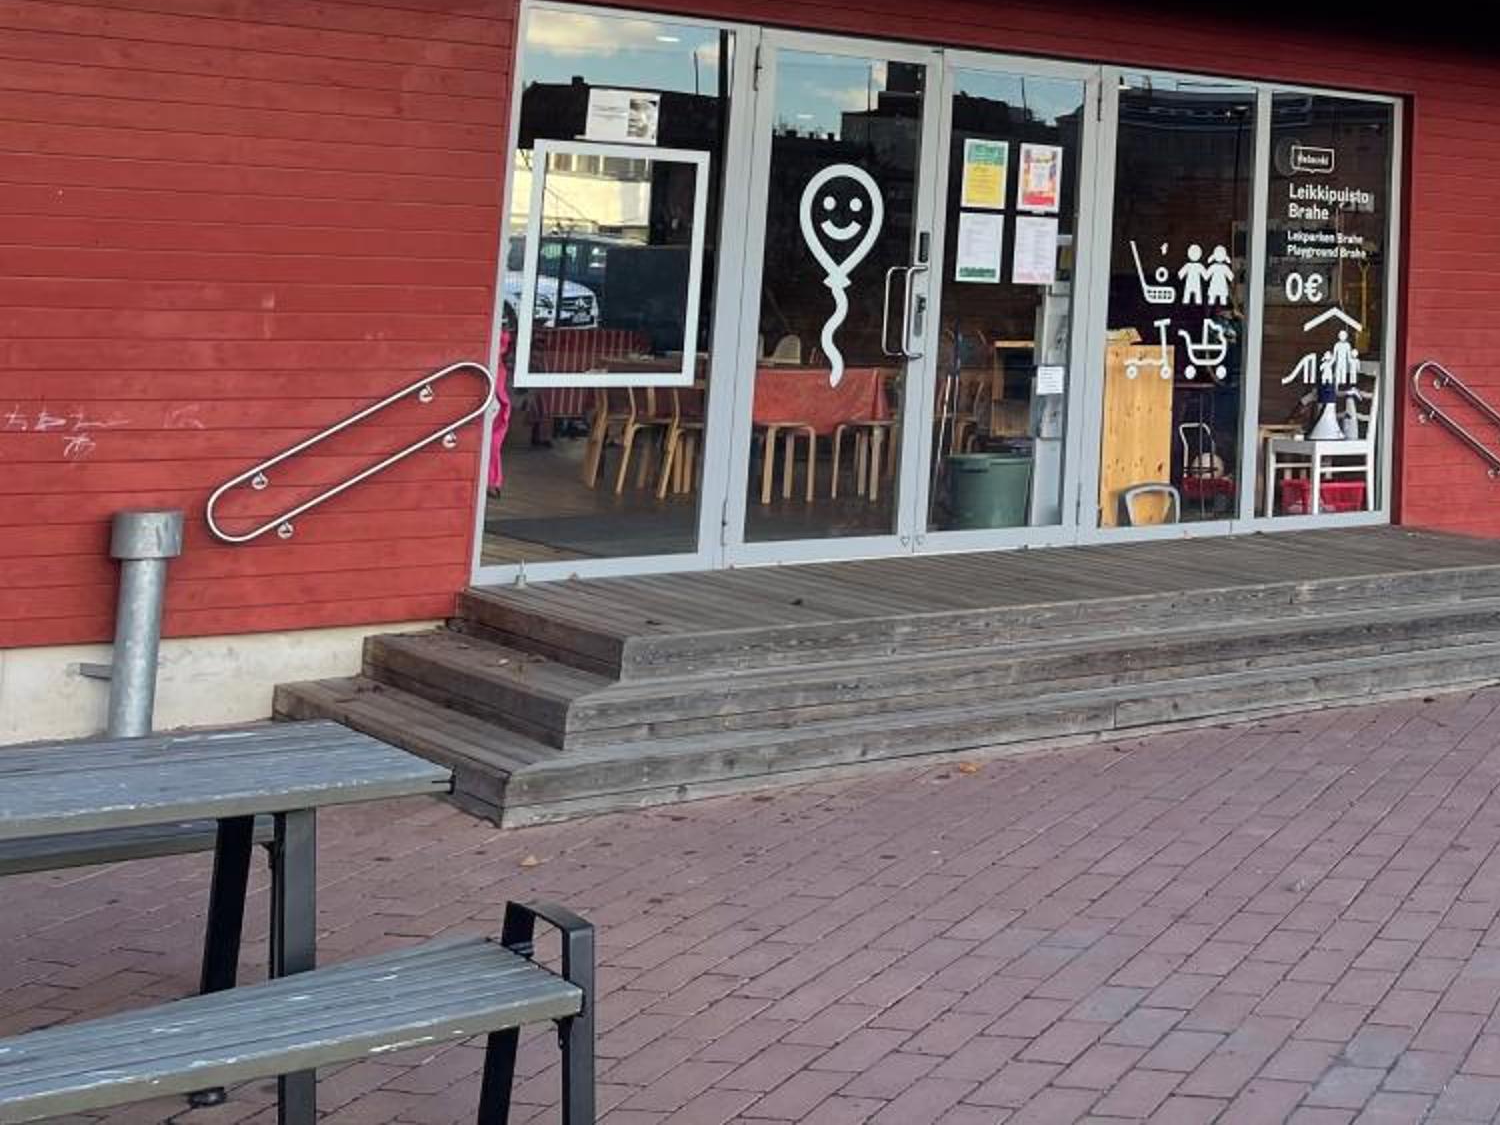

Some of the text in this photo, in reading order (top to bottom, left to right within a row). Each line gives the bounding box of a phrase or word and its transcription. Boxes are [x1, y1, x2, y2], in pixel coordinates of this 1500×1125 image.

[1289, 182, 1369, 205] Leikkipuisto
[1288, 202, 1329, 220] Brahe
[1337, 232, 1363, 244] Brahe
[1286, 244, 1367, 259] Playground Brahe
[1285, 272, 1323, 303] 0€
